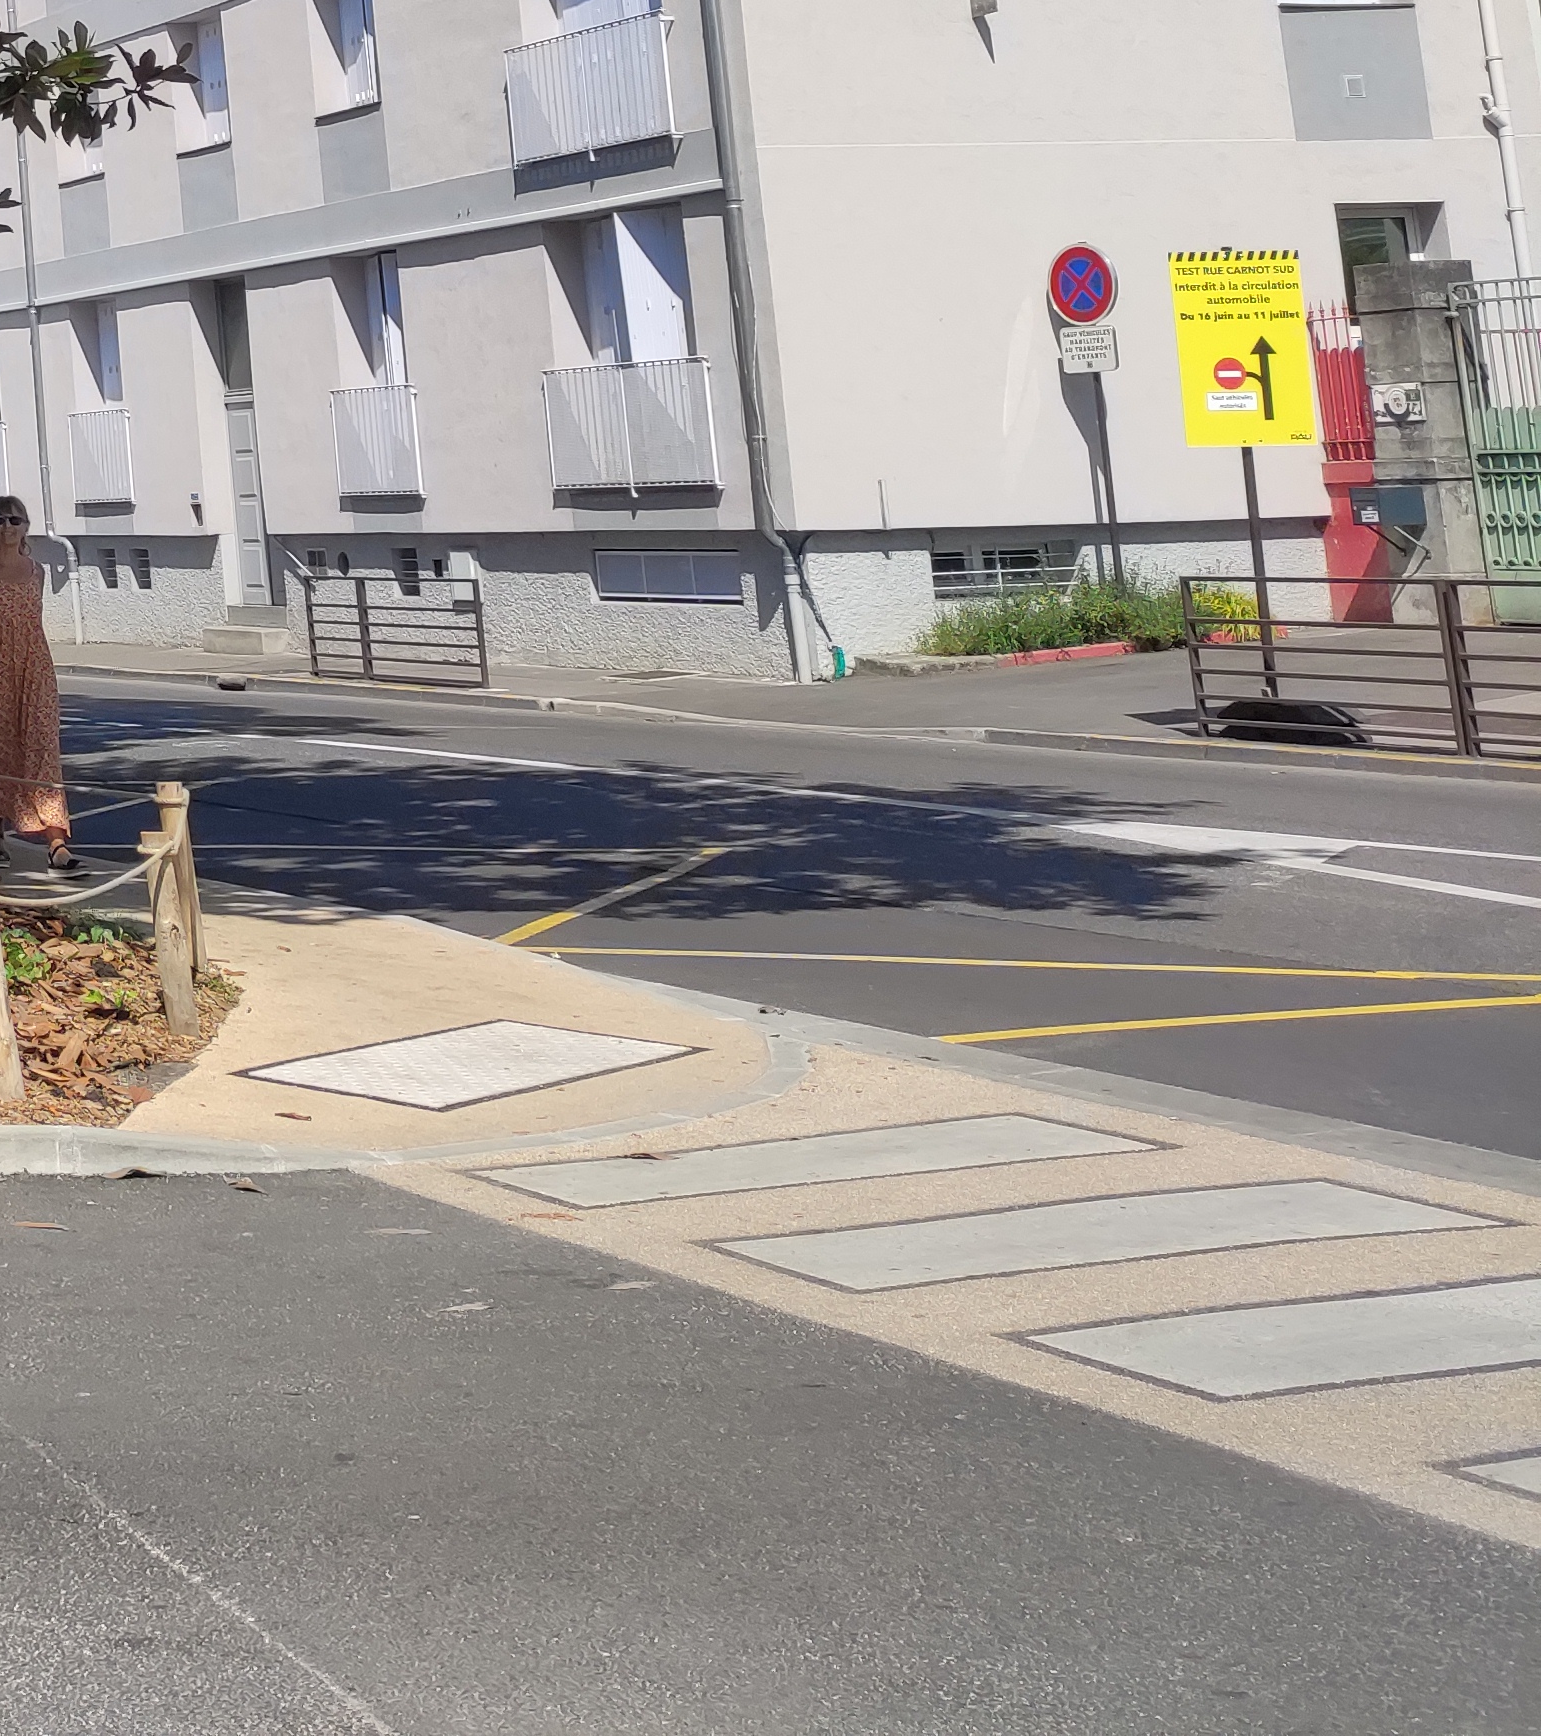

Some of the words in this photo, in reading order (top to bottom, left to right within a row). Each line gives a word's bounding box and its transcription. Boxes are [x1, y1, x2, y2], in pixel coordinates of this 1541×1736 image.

[1175, 267, 1200, 276] TEST
[1203, 266, 1224, 275] RUE
[1226, 265, 1270, 275] CARNOT
[1273, 265, 1295, 274] SUD
[1174, 281, 1216, 292] Interdit
[1219, 281, 1226, 291] à
[1228, 280, 1238, 291] la
[1242, 280, 1299, 290] circulation
[1207, 294, 1271, 304] automobile
[1180, 312, 1195, 321] Du
[1198, 312, 1211, 320] 16
[1213, 311, 1234, 323] juin
[1254, 311, 1266, 320] 11
[1269, 310, 1300, 321] juillet
